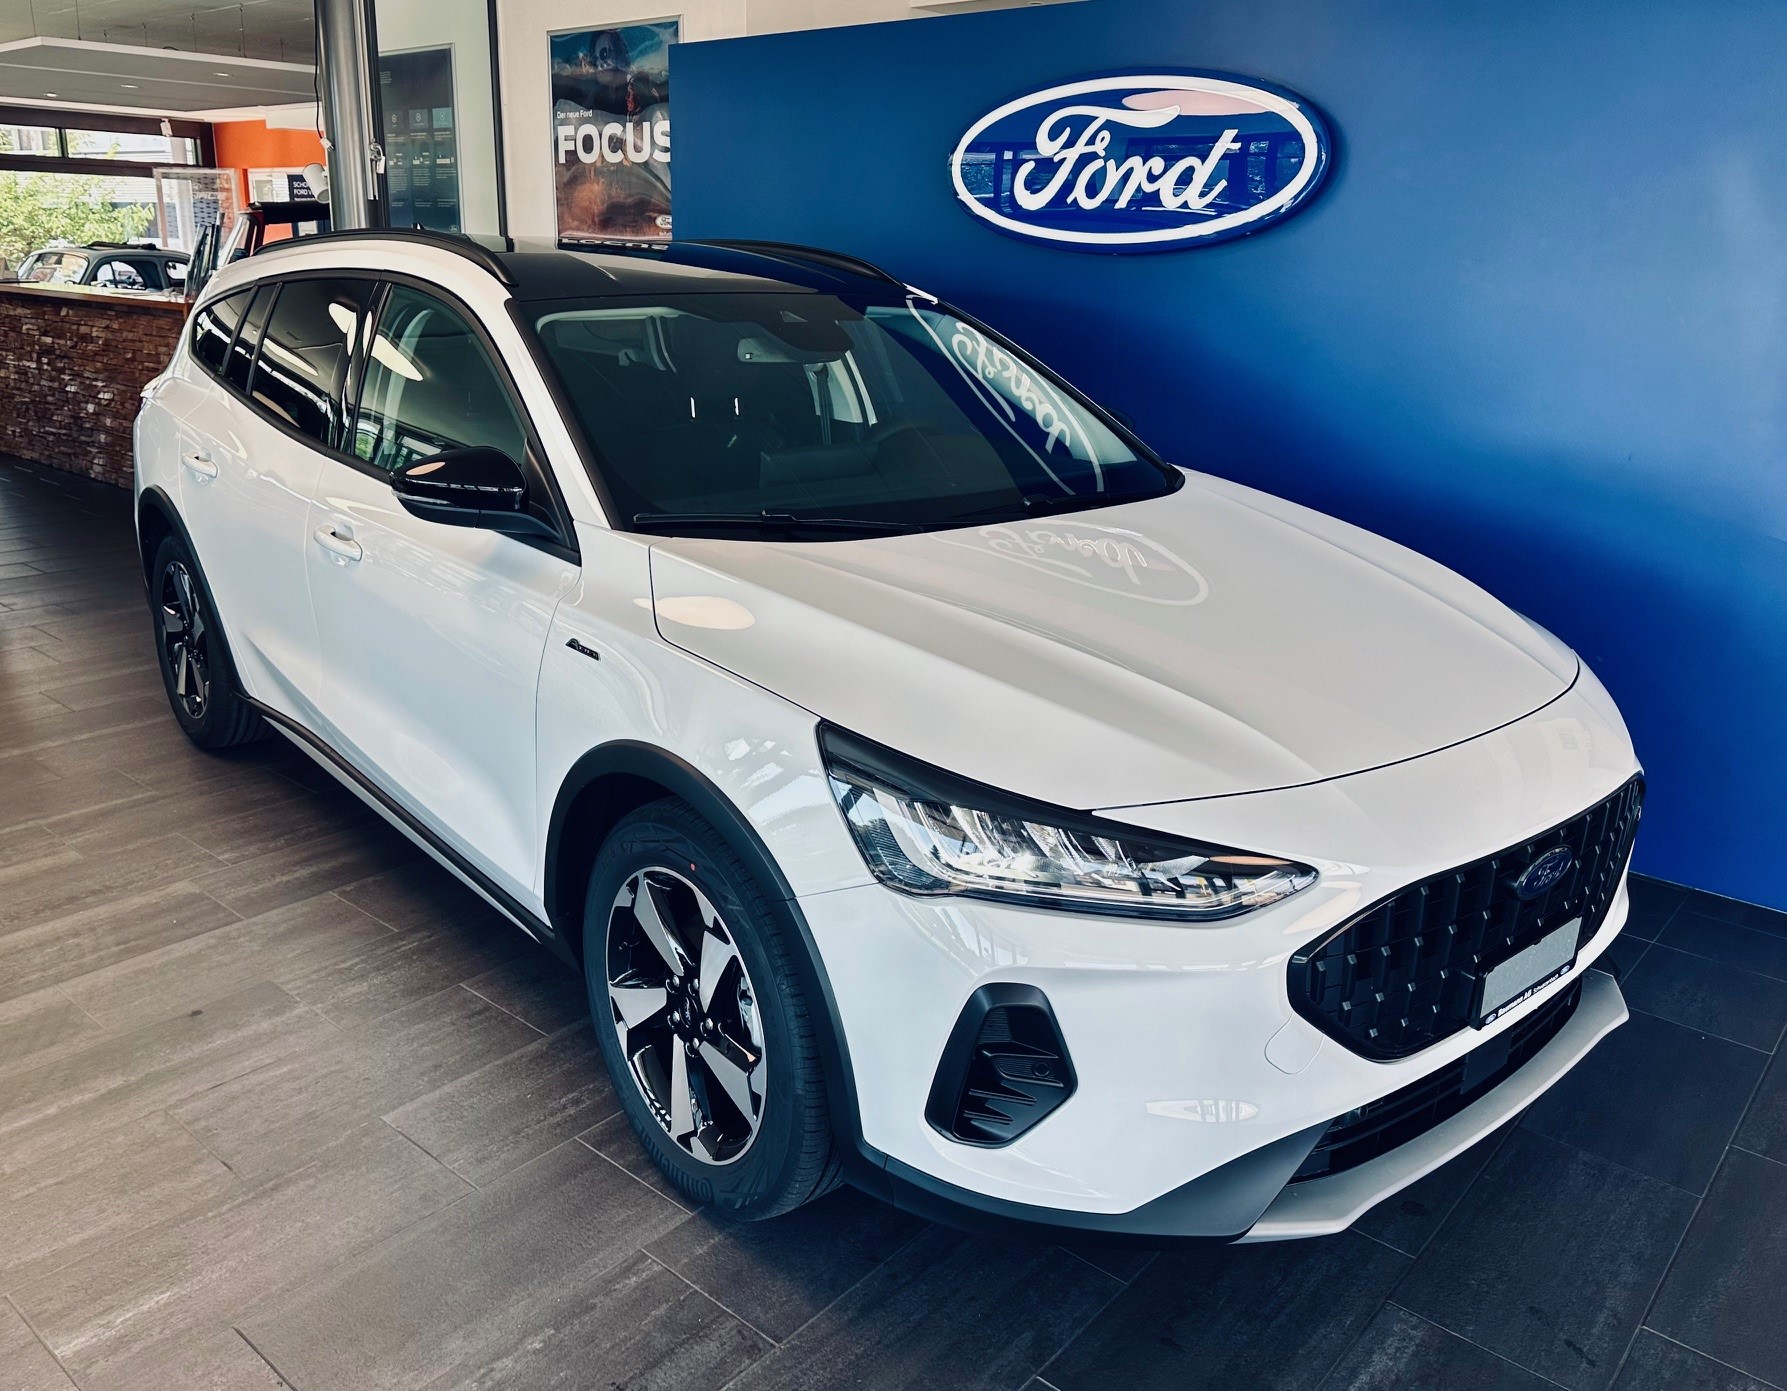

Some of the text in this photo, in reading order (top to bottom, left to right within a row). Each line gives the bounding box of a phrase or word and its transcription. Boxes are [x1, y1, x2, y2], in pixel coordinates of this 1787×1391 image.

[557, 111, 566, 119] Der
[580, 109, 593, 117] Ford
[557, 120, 671, 163] FOCUS
[1013, 105, 1241, 211] Ford
[1533, 859, 1564, 888] Ford
